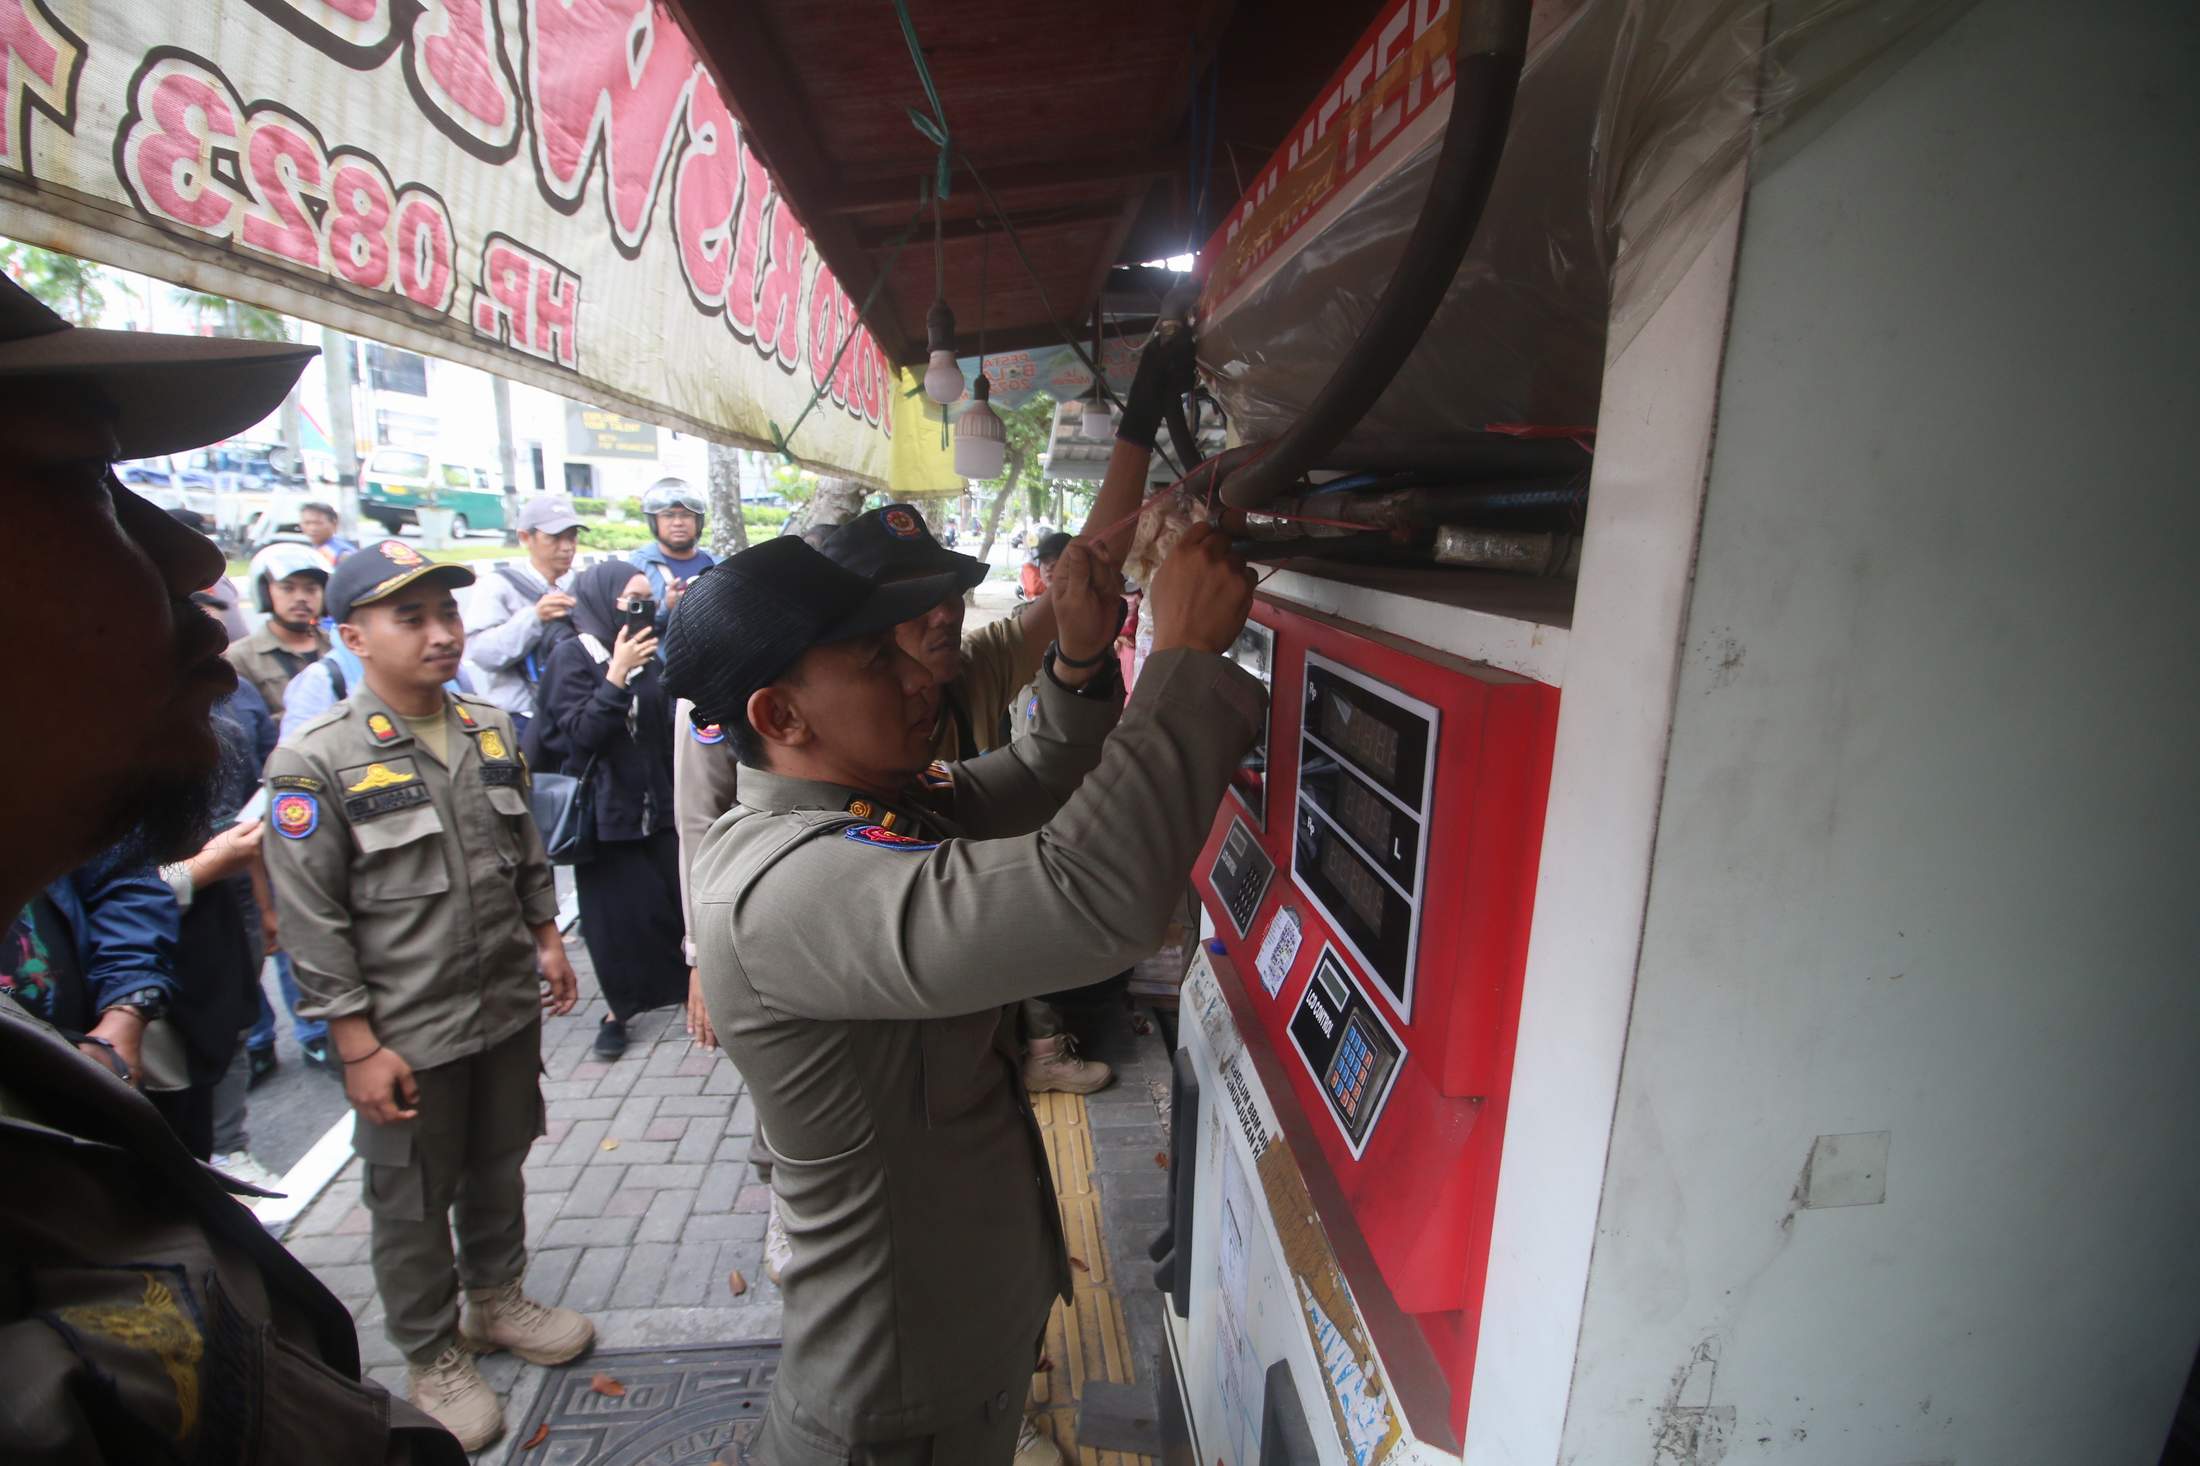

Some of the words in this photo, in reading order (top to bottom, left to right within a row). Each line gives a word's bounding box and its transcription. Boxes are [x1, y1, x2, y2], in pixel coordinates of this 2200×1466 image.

[1309, 682, 1317, 701] Rp
[1307, 815, 1315, 836] Rp
[1394, 837, 1401, 860] L
[1313, 1001, 1334, 1039] CONTROL
[1224, 1075, 1257, 1148] ENUNJUKAN
[1230, 1063, 1251, 1105] EBELUM
[1247, 1102, 1262, 1132] BBM
